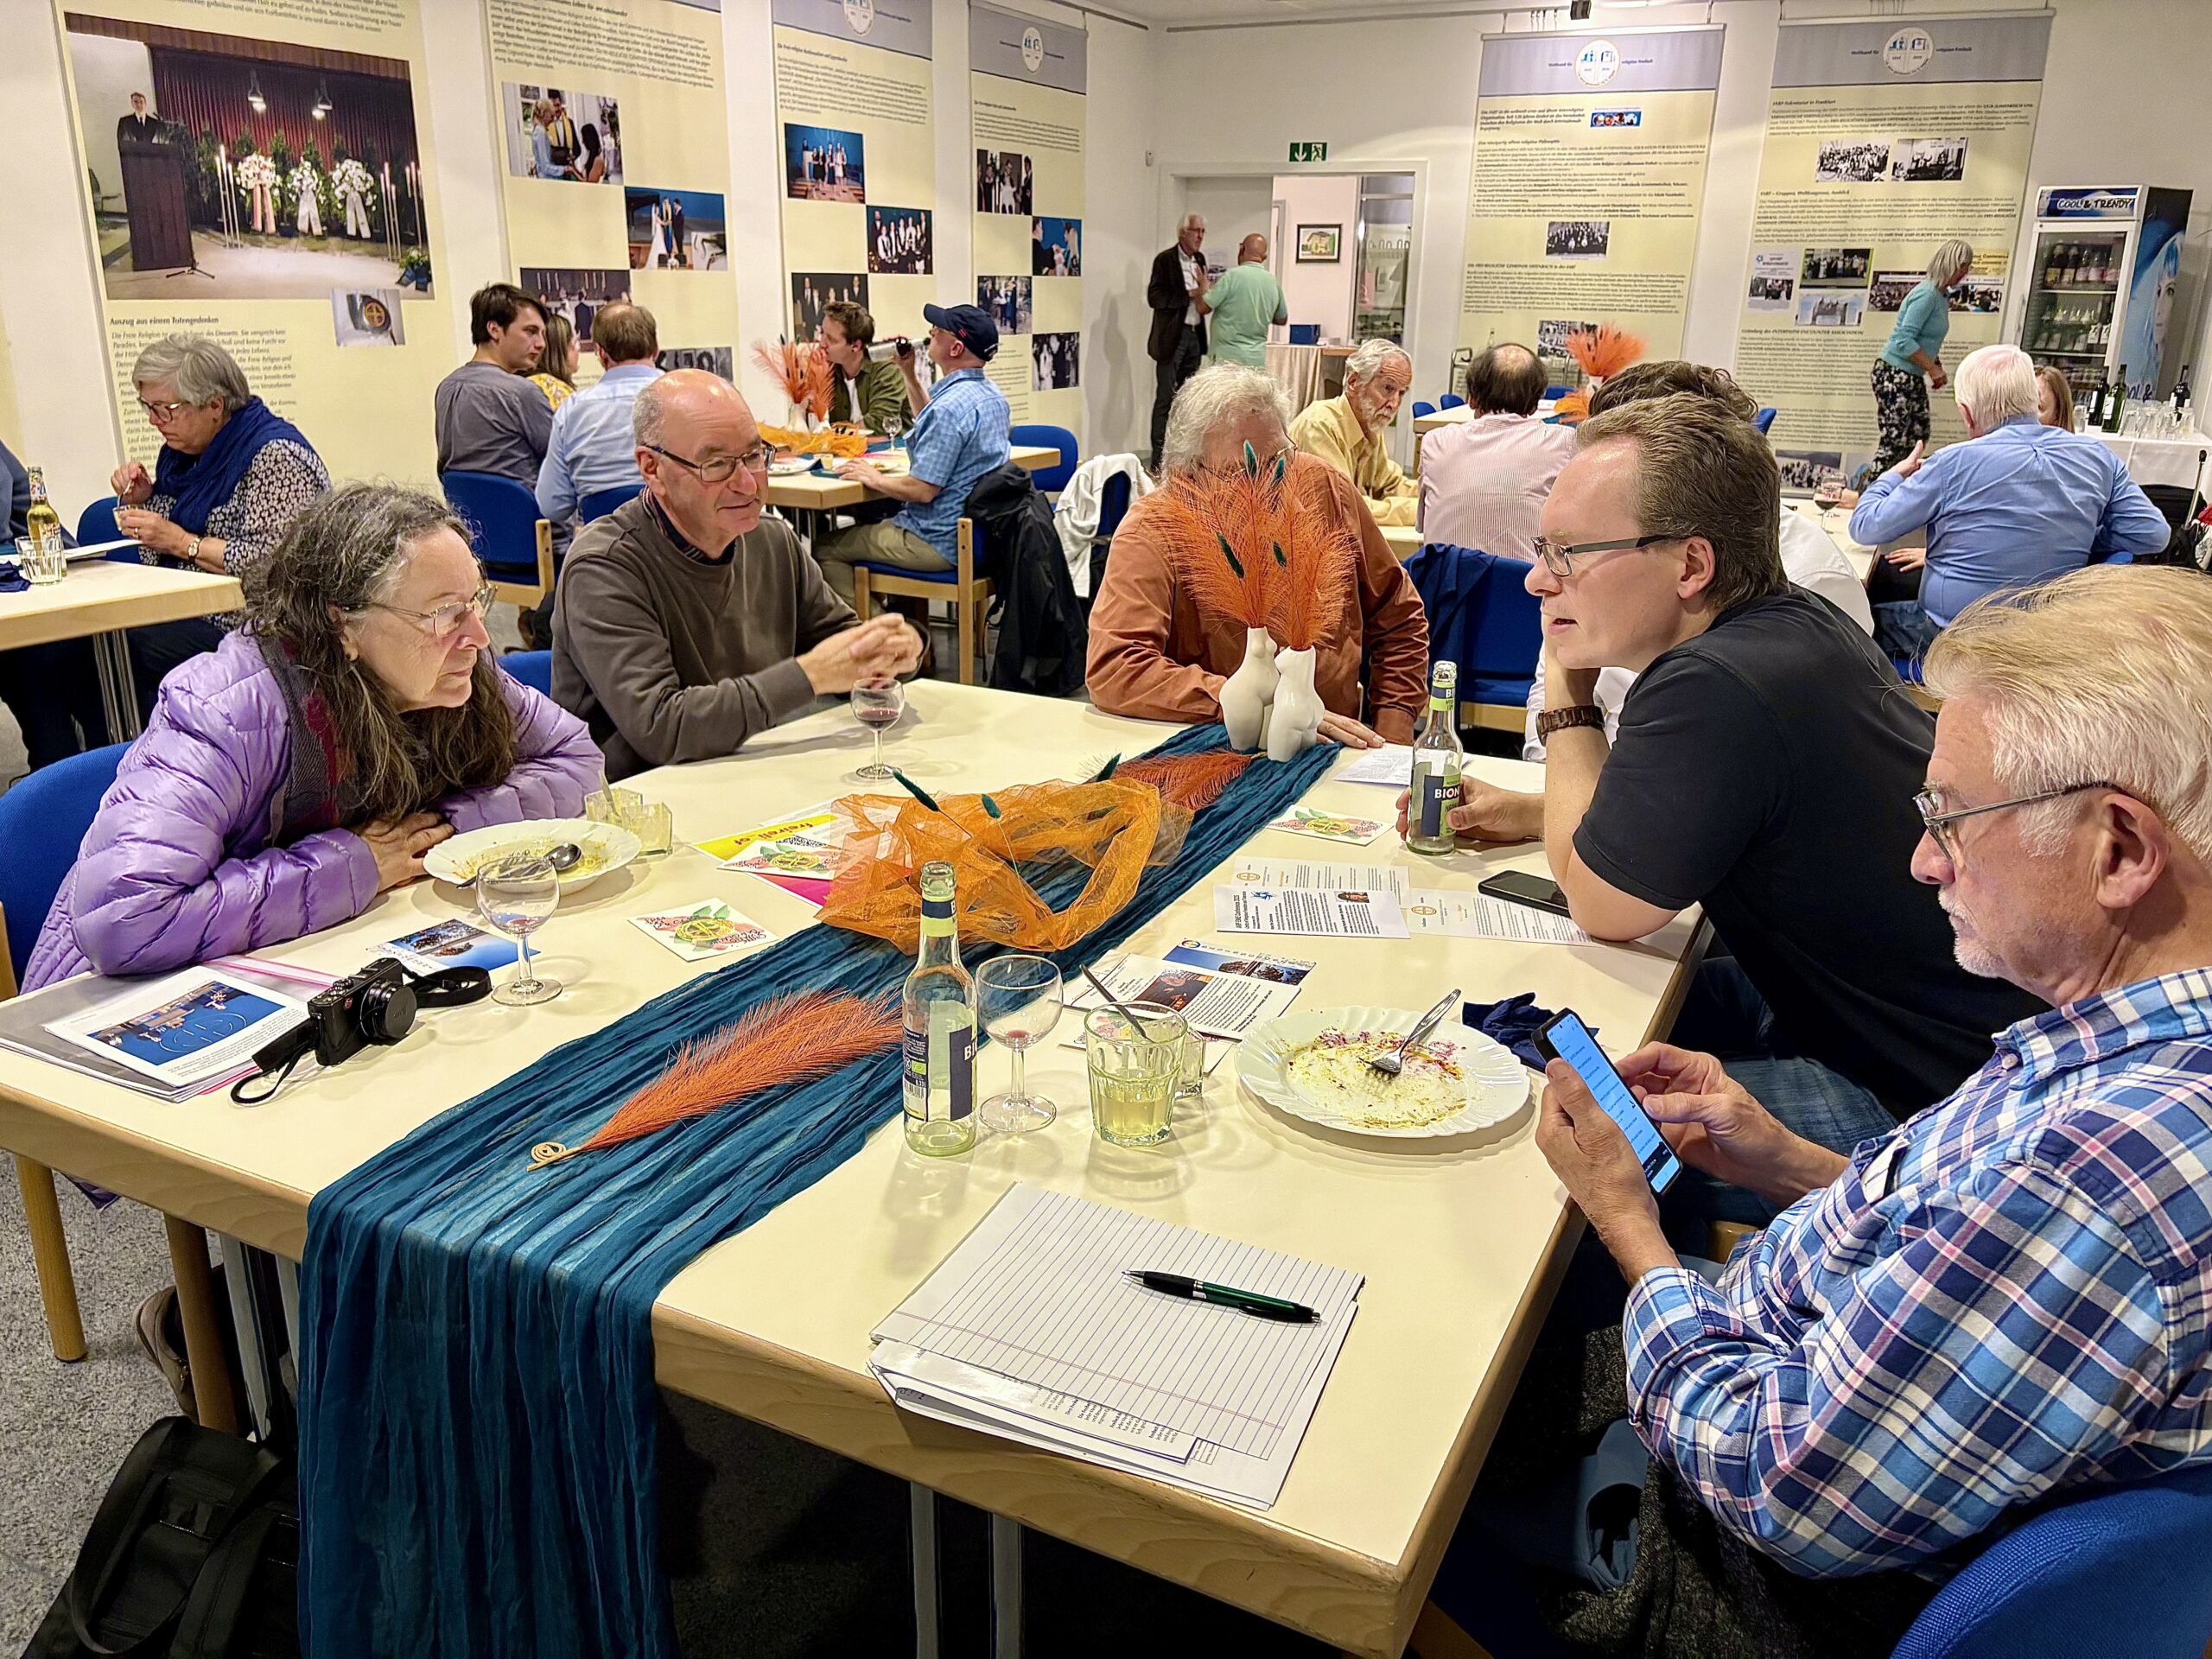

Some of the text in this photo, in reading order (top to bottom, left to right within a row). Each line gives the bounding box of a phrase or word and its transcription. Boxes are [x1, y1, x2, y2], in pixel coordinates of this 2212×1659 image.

[2058, 198, 2134, 209] COOL & TRENDY
[110, 317, 135, 327] Auszug
[149, 316, 170, 325] einem
[963, 1039, 978, 1061] BI
